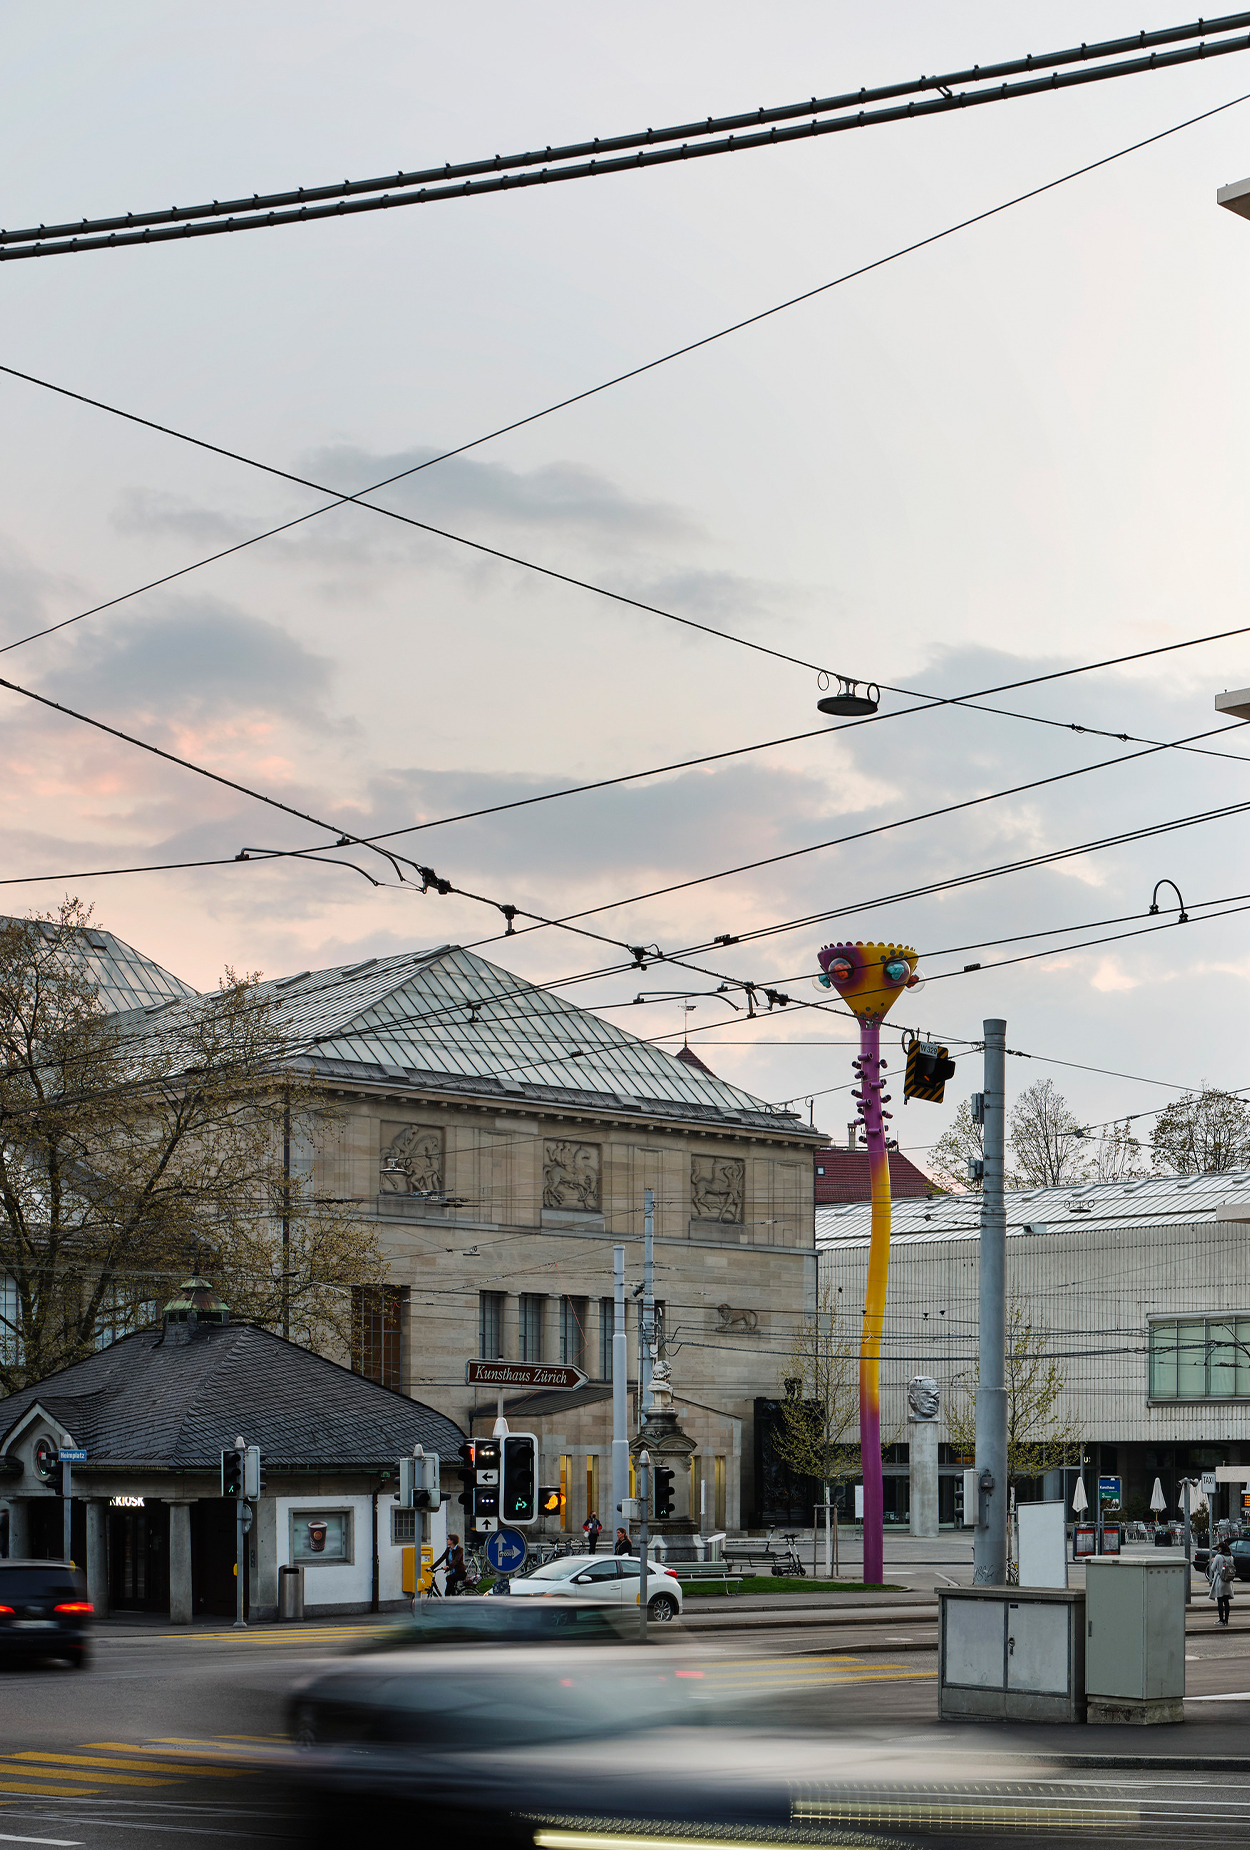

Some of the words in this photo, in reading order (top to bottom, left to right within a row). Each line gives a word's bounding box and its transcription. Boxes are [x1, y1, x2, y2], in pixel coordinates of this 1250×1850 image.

[474, 1365, 531, 1383] Kunsthaus
[533, 1367, 568, 1384] Zürich
[60, 1452, 85, 1460] Heimplatz
[1203, 1476, 1214, 1484] TAXI
